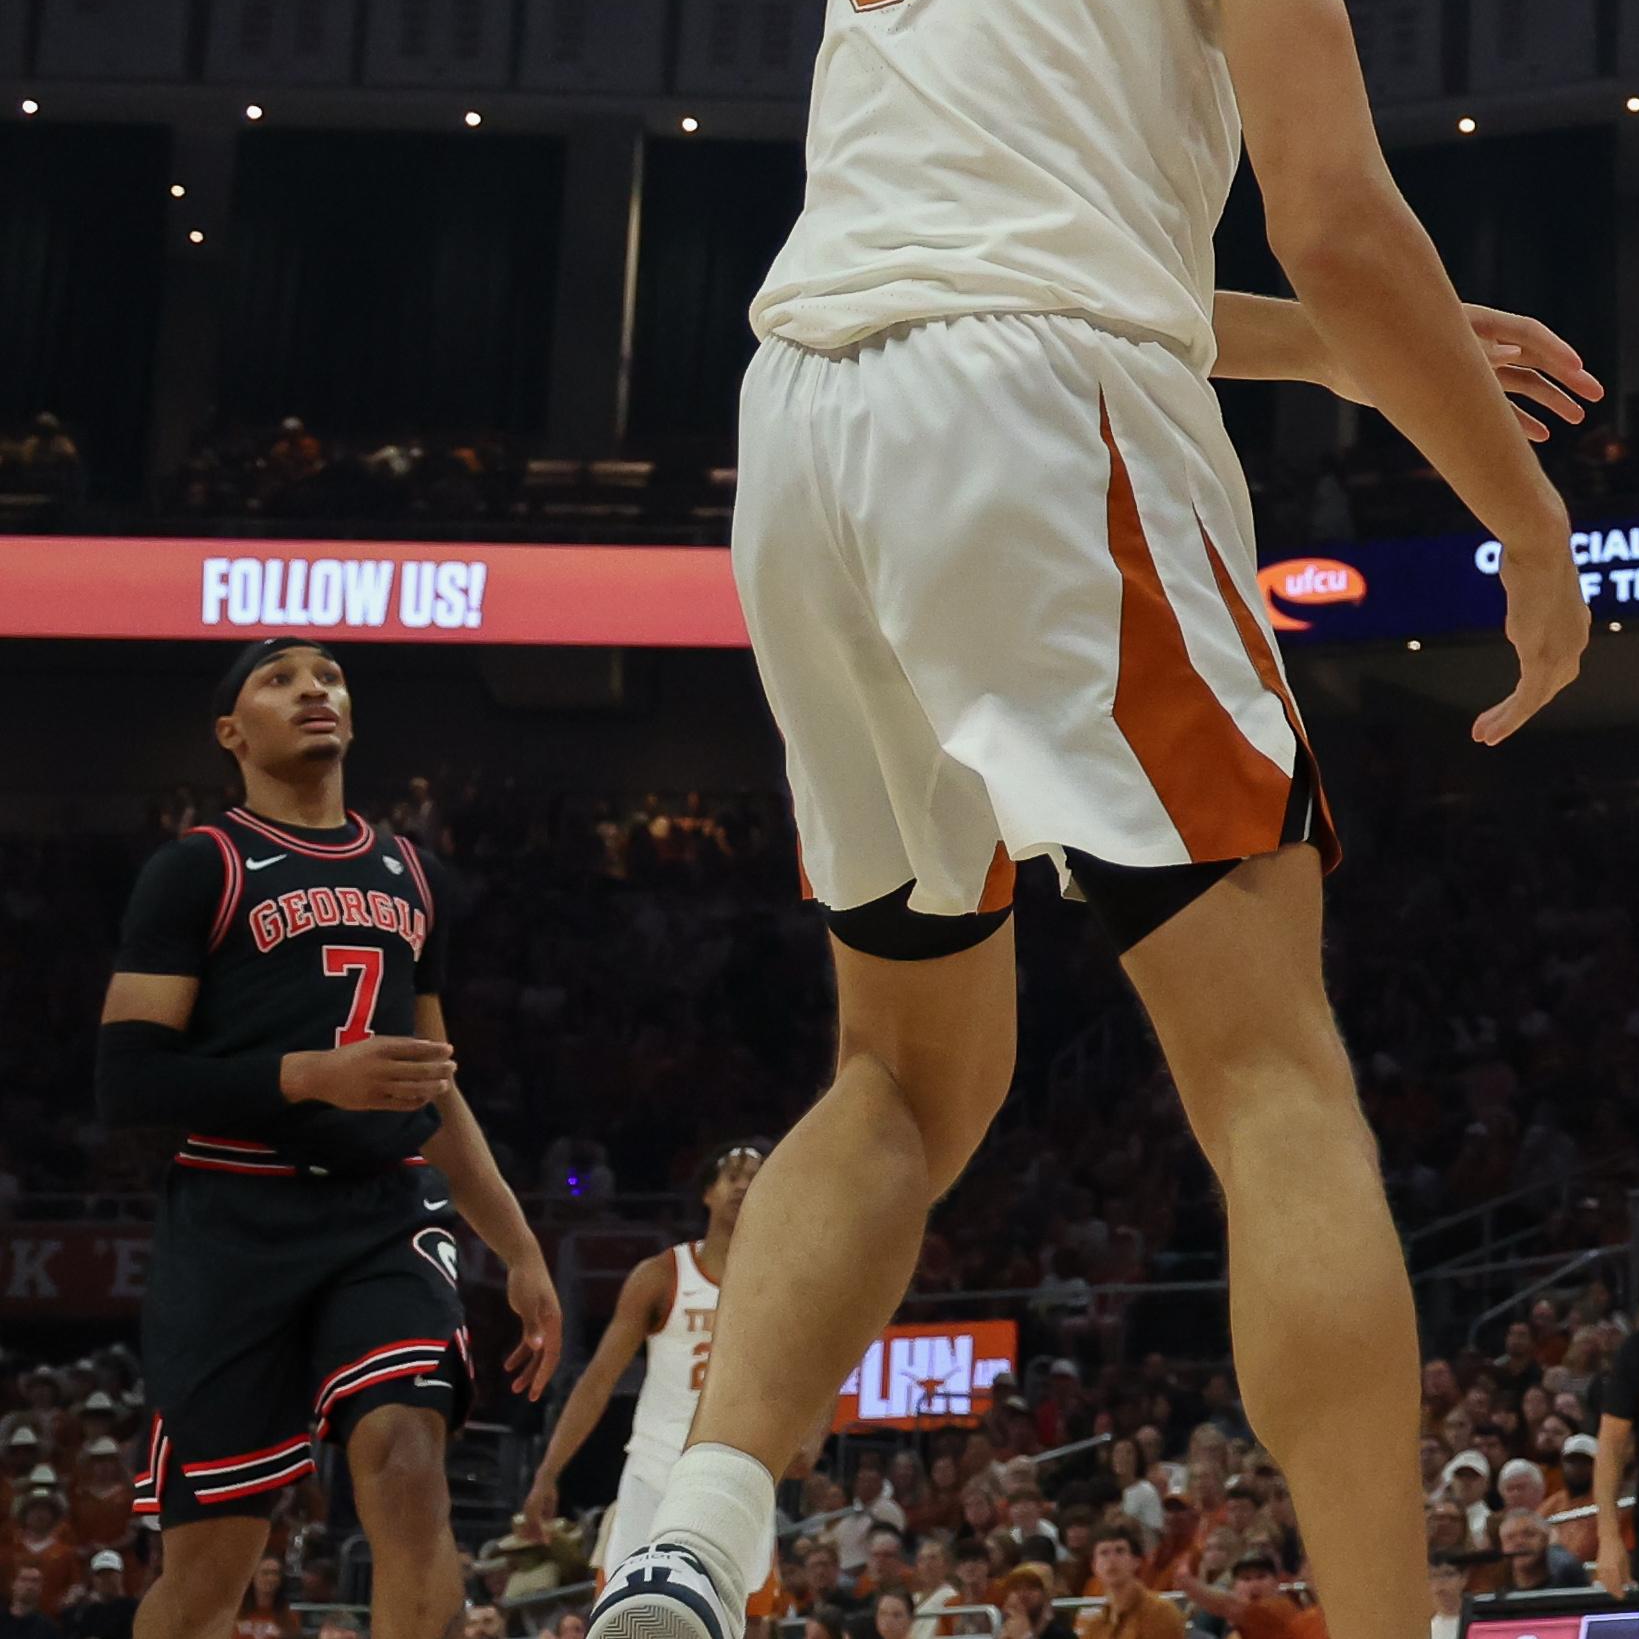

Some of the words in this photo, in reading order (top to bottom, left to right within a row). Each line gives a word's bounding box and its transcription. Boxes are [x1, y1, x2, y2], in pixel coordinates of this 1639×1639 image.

[201, 557, 396, 628] FOLLOW
[399, 559, 488, 629] US!
[249, 886, 427, 963] GEORGIA
[321, 944, 385, 1050] 7
